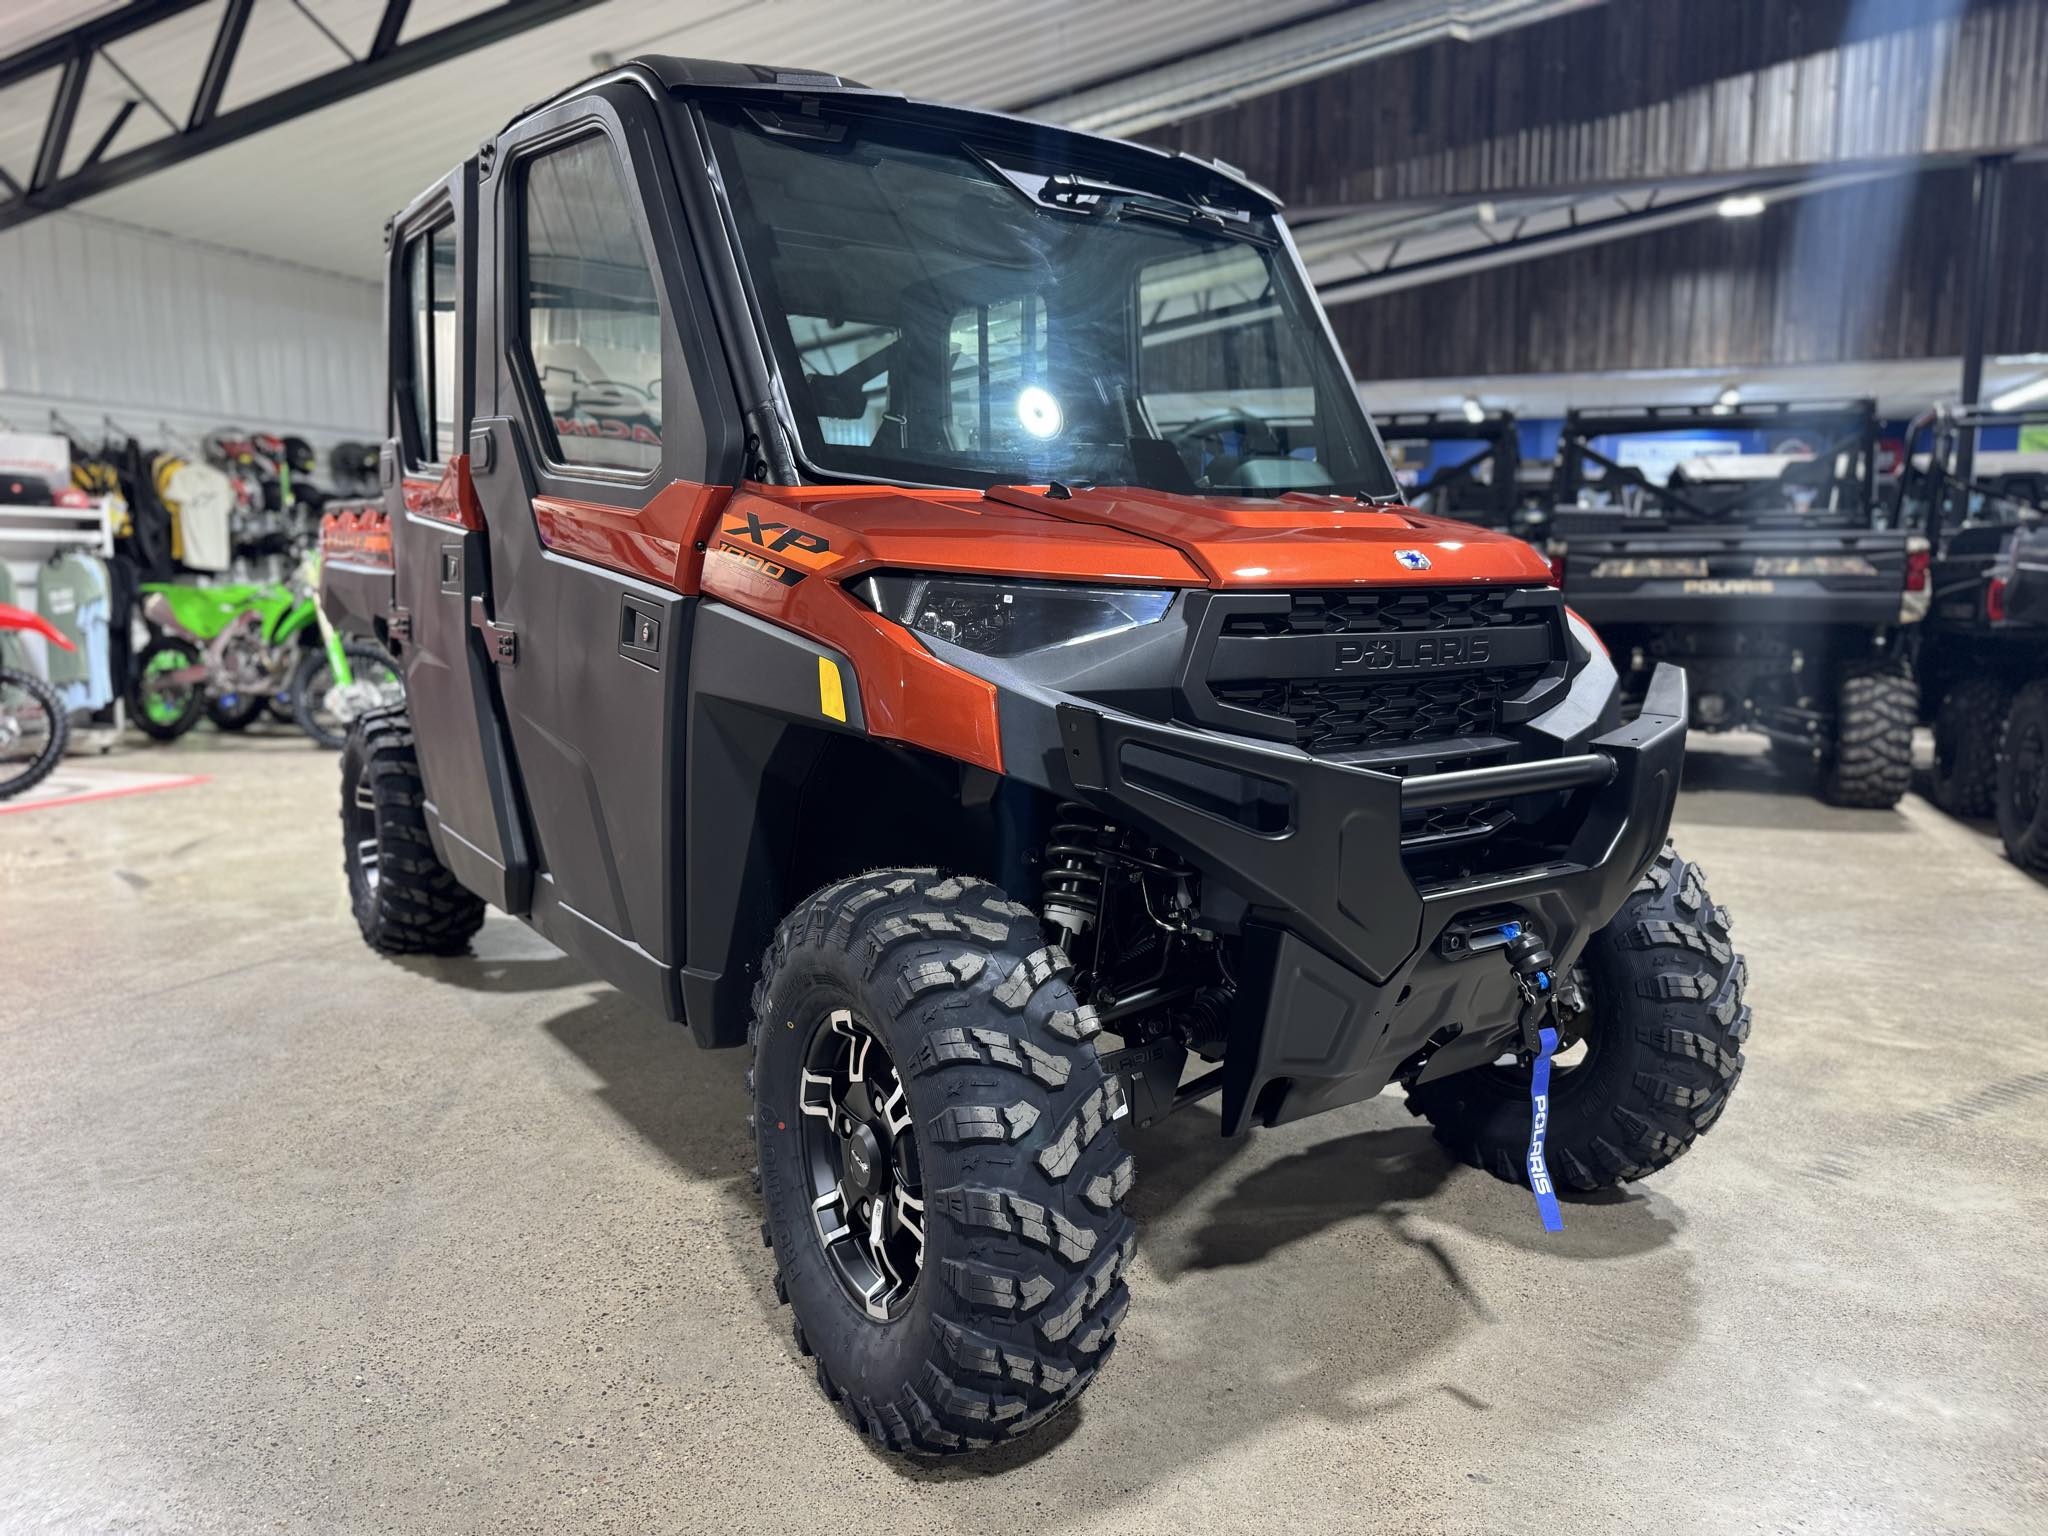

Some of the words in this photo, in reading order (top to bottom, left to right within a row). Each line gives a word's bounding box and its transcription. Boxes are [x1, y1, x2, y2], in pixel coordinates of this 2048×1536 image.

[722, 511, 830, 554] XP
[719, 543, 785, 580] 1000
[1684, 579, 1774, 594] POLARIS
[1335, 635, 1490, 671] POLARIS
[1529, 1094, 1551, 1195] POLARIS
